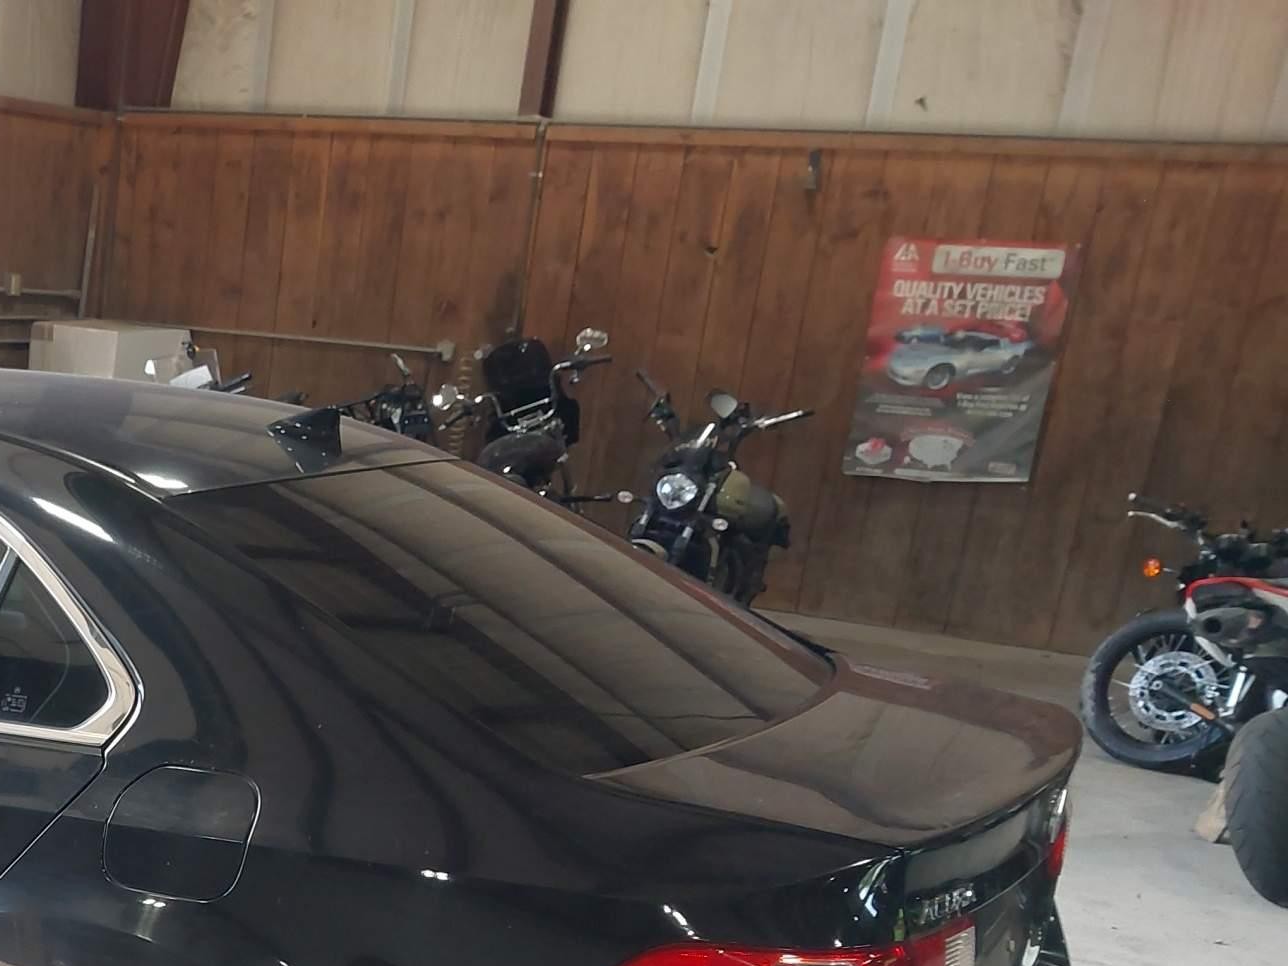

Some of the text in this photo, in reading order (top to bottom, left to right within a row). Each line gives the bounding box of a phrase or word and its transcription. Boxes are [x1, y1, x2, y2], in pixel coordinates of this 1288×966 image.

[1003, 252, 1048, 272] Fast
[893, 279, 1046, 305] QUALITY VEHICLES
[901, 298, 926, 316] AT
[925, 299, 939, 317] A
[943, 300, 975, 320] SET
